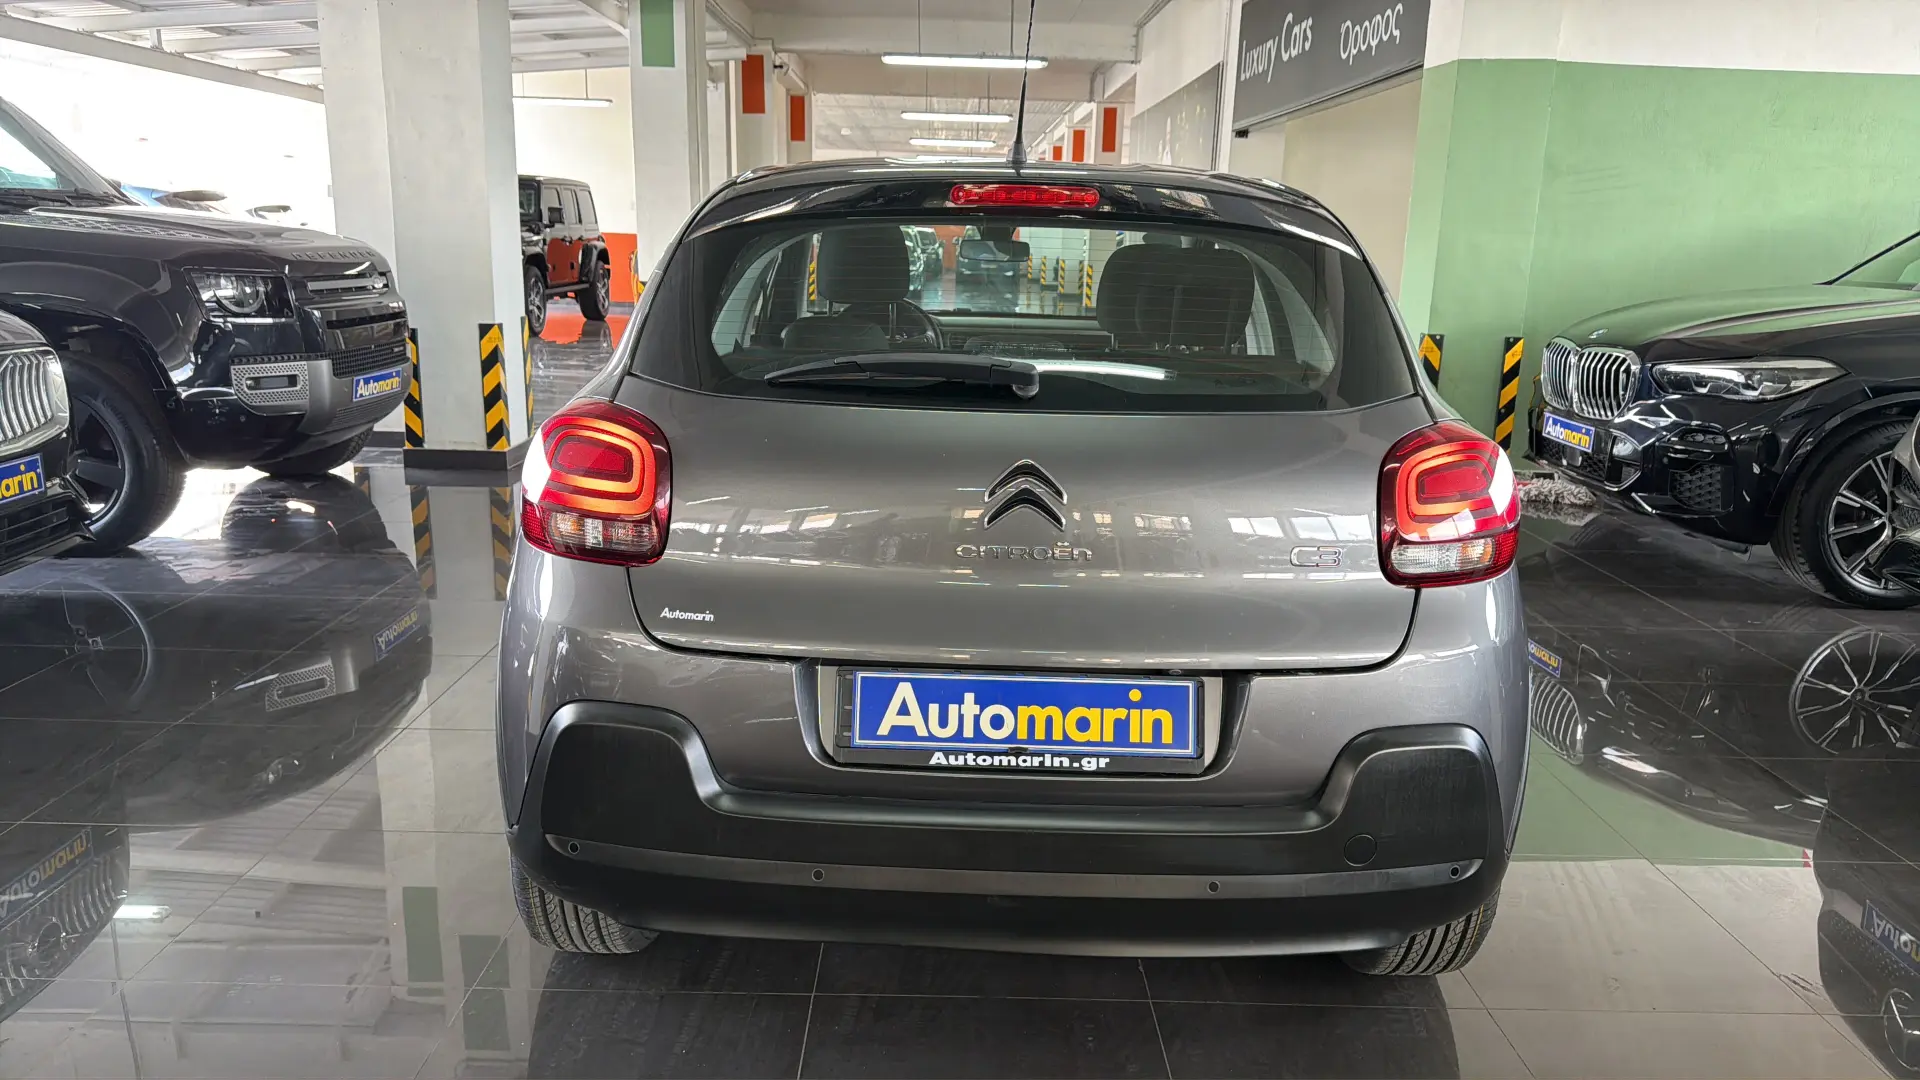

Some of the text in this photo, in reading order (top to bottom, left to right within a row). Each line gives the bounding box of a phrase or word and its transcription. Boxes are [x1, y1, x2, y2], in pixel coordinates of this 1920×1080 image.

[1240, 12, 1313, 83] Luxury Cars
[356, 371, 400, 398] Automarin
[1545, 416, 1590, 448] Automarin
[0, 464, 38, 499] arin
[1290, 545, 1343, 568] C3
[659, 607, 714, 622] Automarin
[876, 681, 1173, 744] Automarin
[929, 751, 1110, 771] Automarin.gr
